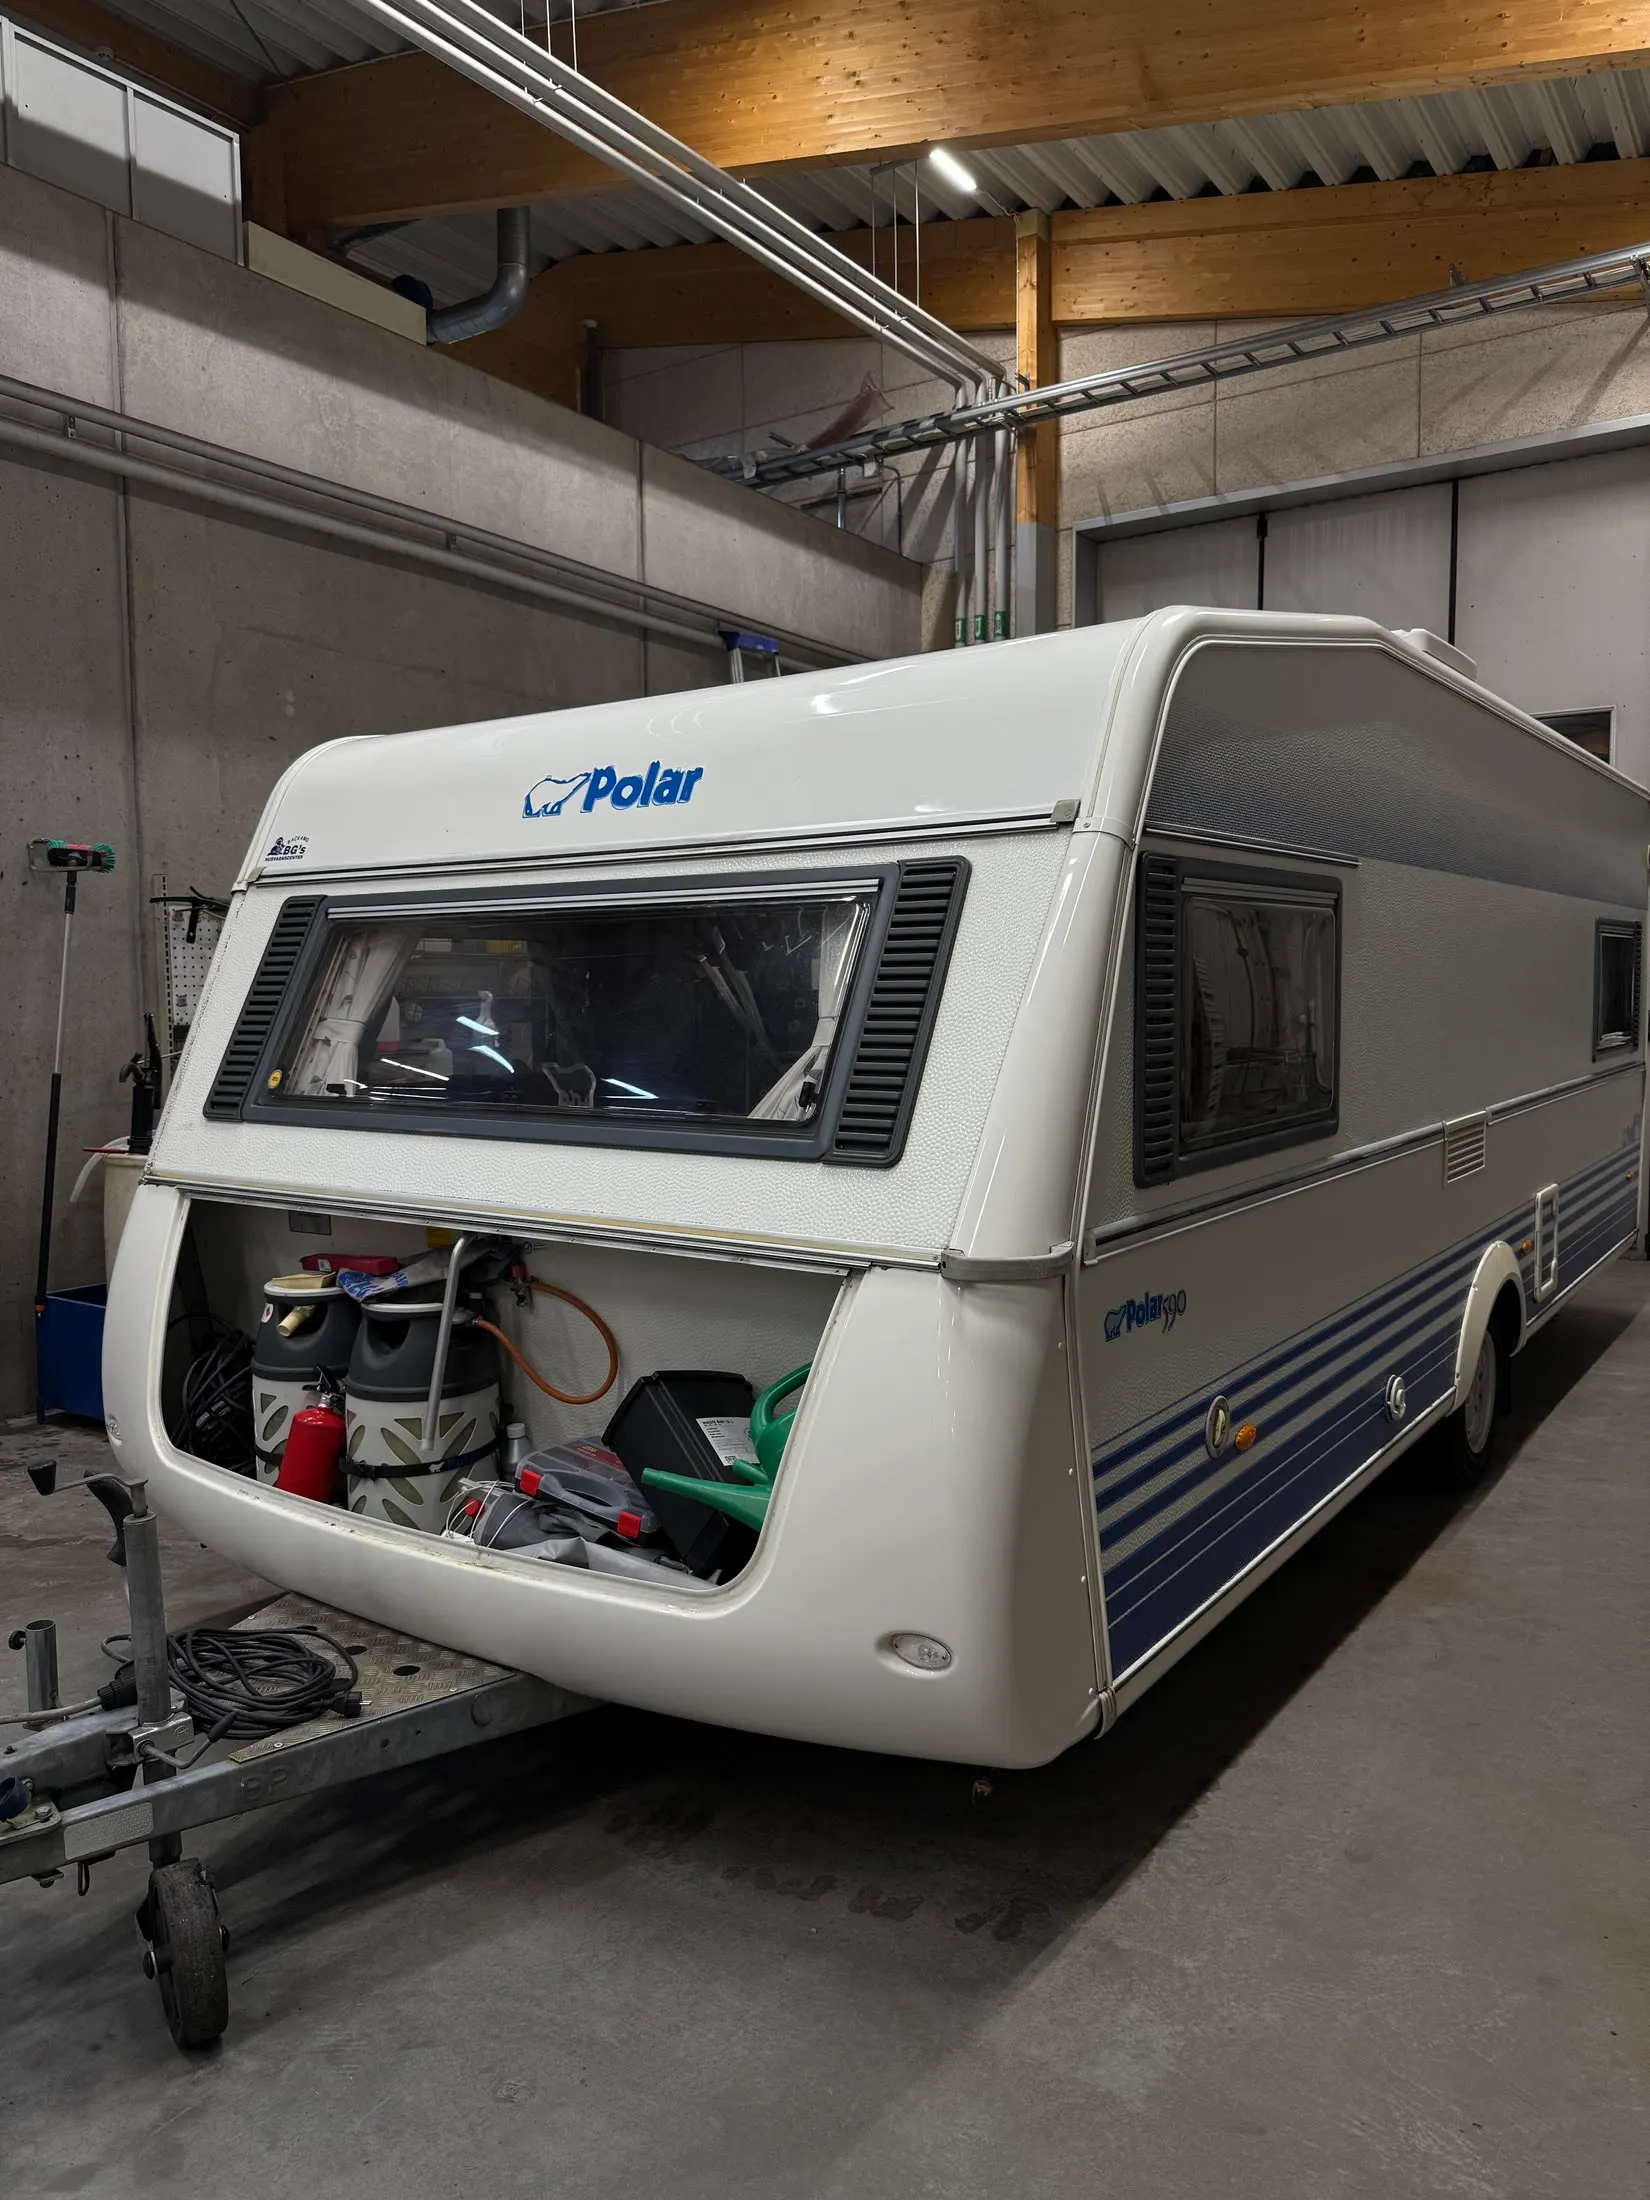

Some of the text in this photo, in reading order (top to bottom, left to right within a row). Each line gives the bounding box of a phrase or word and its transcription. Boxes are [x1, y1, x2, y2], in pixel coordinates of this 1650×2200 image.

[579, 760, 704, 813] Polar
[283, 844, 307, 855] BG's
[1126, 1289, 1187, 1334] Polar 590
